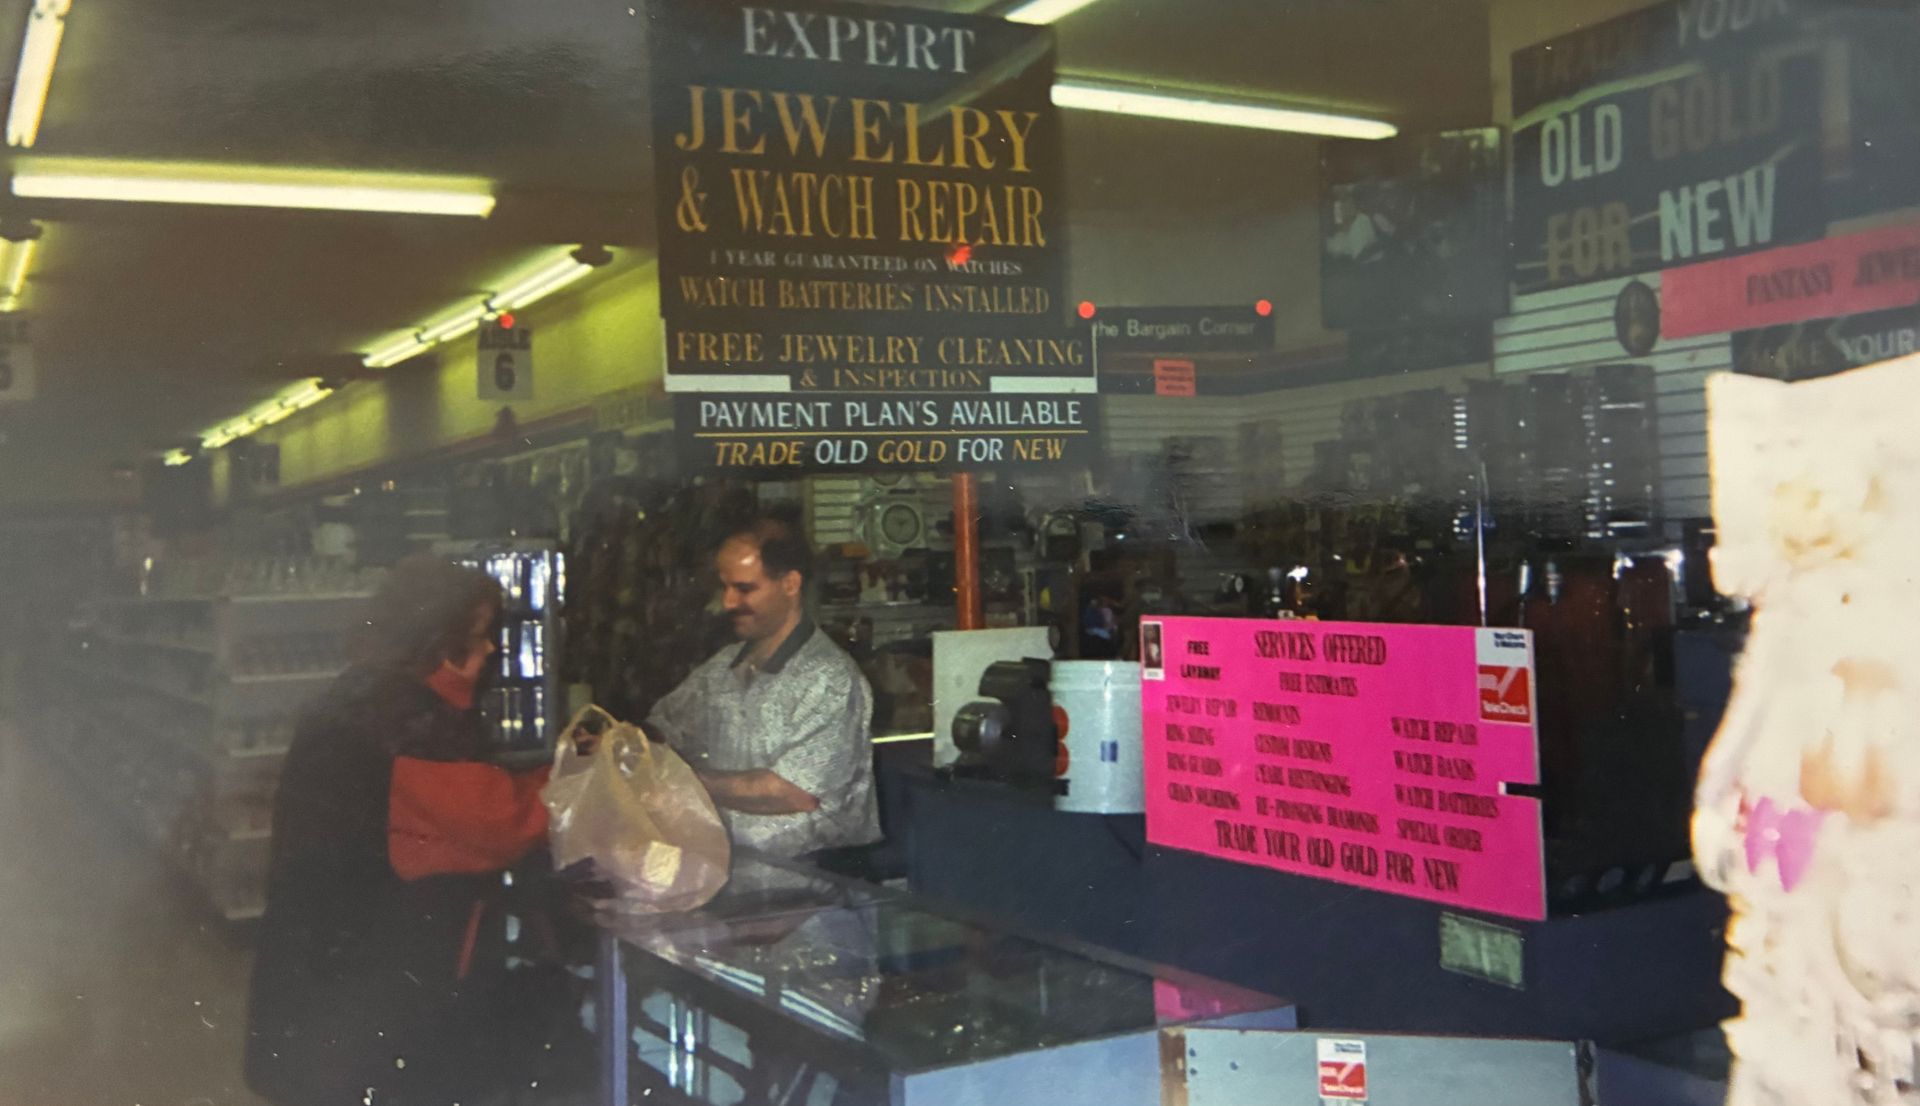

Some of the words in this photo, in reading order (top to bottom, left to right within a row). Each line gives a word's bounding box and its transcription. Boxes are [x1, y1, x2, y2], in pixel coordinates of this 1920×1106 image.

[742, 7, 975, 73] EXPERT
[676, 85, 1039, 173] JEWELRY
[1541, 104, 1622, 187] OLD
[1650, 57, 1781, 161] GOLD
[677, 165, 707, 232] &
[730, 168, 878, 240] WATCH
[898, 178, 1046, 247] REPAIR
[1546, 202, 1631, 281] FOR
[1659, 163, 1776, 261] NEW
[726, 251, 776, 268] YEAR
[784, 253, 908, 272] GUARANTEED
[915, 258, 938, 272] ON
[947, 258, 1022, 275] WATCHES
[679, 276, 765, 308] WATCH
[779, 280, 913, 312] BATTERIES
[925, 284, 1050, 315] INSTALLED
[1746, 261, 1832, 306] FANTASY
[1097, 319, 1118, 337] he
[1127, 319, 1191, 339] Bargain
[1199, 317, 1256, 336] Corner
[677, 333, 763, 362] FREE
[779, 335, 924, 365] JEWELRY
[938, 338, 1084, 366] CLEANING
[1841, 328, 1916, 362] YOUR
[495, 353, 515, 391] 6
[800, 371, 818, 388] &
[834, 369, 983, 388] INSPECTION
[701, 401, 832, 428] PAYMENT
[845, 401, 938, 427] PLAN'S
[950, 401, 1082, 425] AVAILABLE
[715, 441, 804, 466] TRADE
[815, 439, 868, 464] OLD
[878, 440, 947, 463] GOLD
[957, 438, 1004, 462] FOR
[1013, 438, 1067, 461] NEW
[1187, 640, 1209, 656] FREE
[1254, 630, 1316, 661] SERVICES
[1323, 633, 1387, 665] OFFERED
[1181, 664, 1221, 681] LAYAWAY
[1279, 671, 1301, 692] FREE
[1305, 674, 1358, 697] ESTIMATES
[1166, 694, 1202, 714] JEWELRY
[1205, 697, 1237, 718] REPAIR
[1166, 723, 1185, 742] RING
[1391, 717, 1431, 741] WATCH
[1434, 720, 1478, 745] REPAIR
[1167, 752, 1186, 771] RING
[1255, 733, 1290, 756] CUSTOM
[1293, 738, 1333, 764] DESIGNS
[1393, 750, 1433, 776] WATCH
[1437, 755, 1477, 781] BANDS
[1394, 783, 1434, 810] WATCH
[1438, 790, 1499, 818] BATTERIES
[1326, 806, 1379, 835] DIAMONDS
[1397, 818, 1441, 846] SPECIAL
[1443, 825, 1483, 853] ORDER
[1215, 819, 1258, 854] TRADE
[1264, 828, 1301, 862] YOUR
[1306, 836, 1335, 868] OLD
[1340, 841, 1379, 877] GOLD
[1385, 850, 1415, 884] FOR
[1423, 857, 1461, 892] NEW
